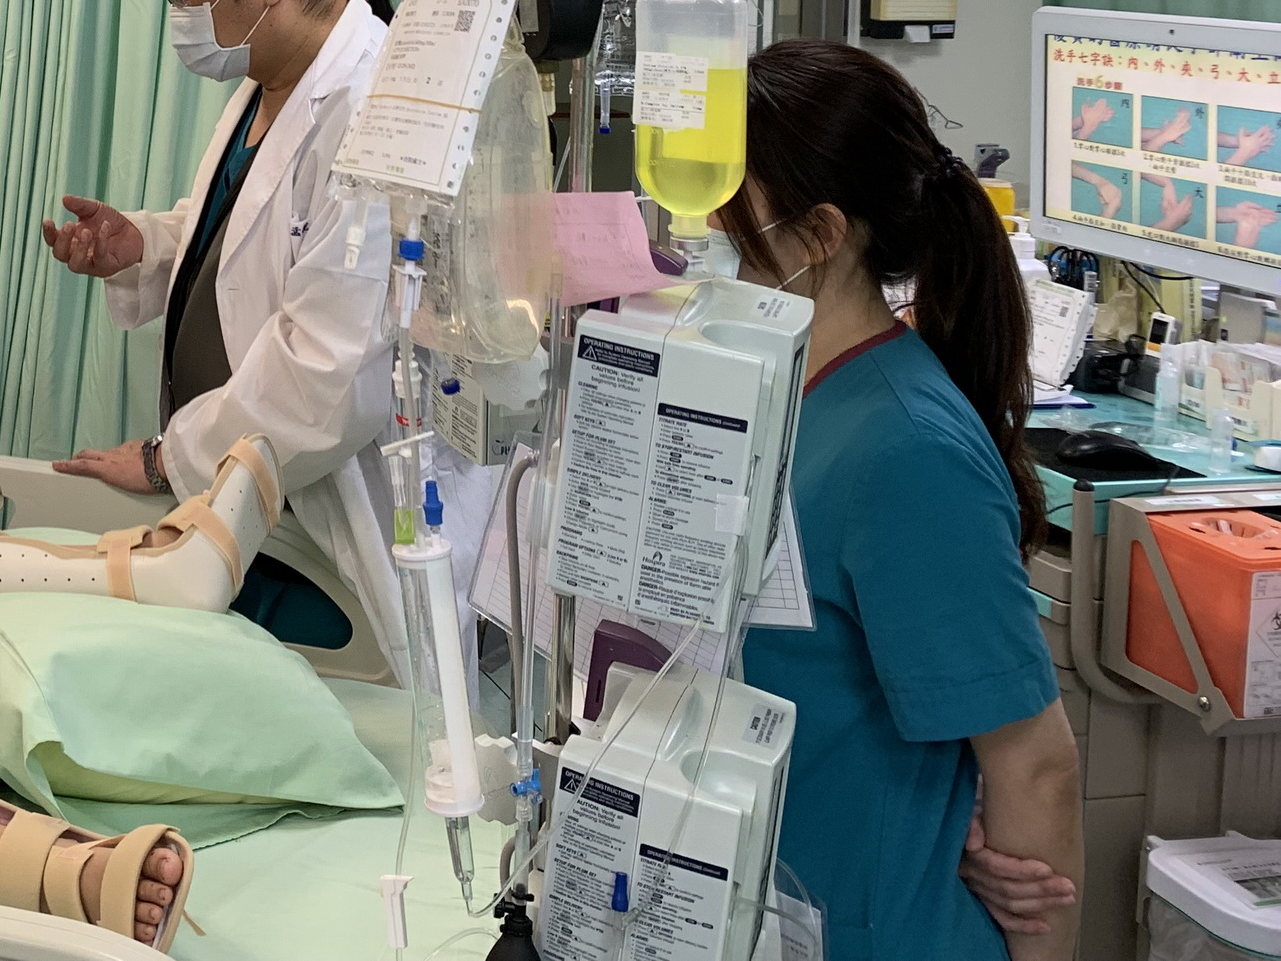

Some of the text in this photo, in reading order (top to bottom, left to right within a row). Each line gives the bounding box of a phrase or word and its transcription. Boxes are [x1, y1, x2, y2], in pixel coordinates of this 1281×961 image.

[1121, 172, 1129, 185] 弓
[1193, 187, 1204, 199] 大
[583, 338, 654, 360] OPERATING INSTRUCTIONS
[596, 783, 633, 800] INSTRUCTIONS
[573, 809, 597, 821] beginning
[598, 813, 614, 822] before
[601, 809, 615, 817] Verify
